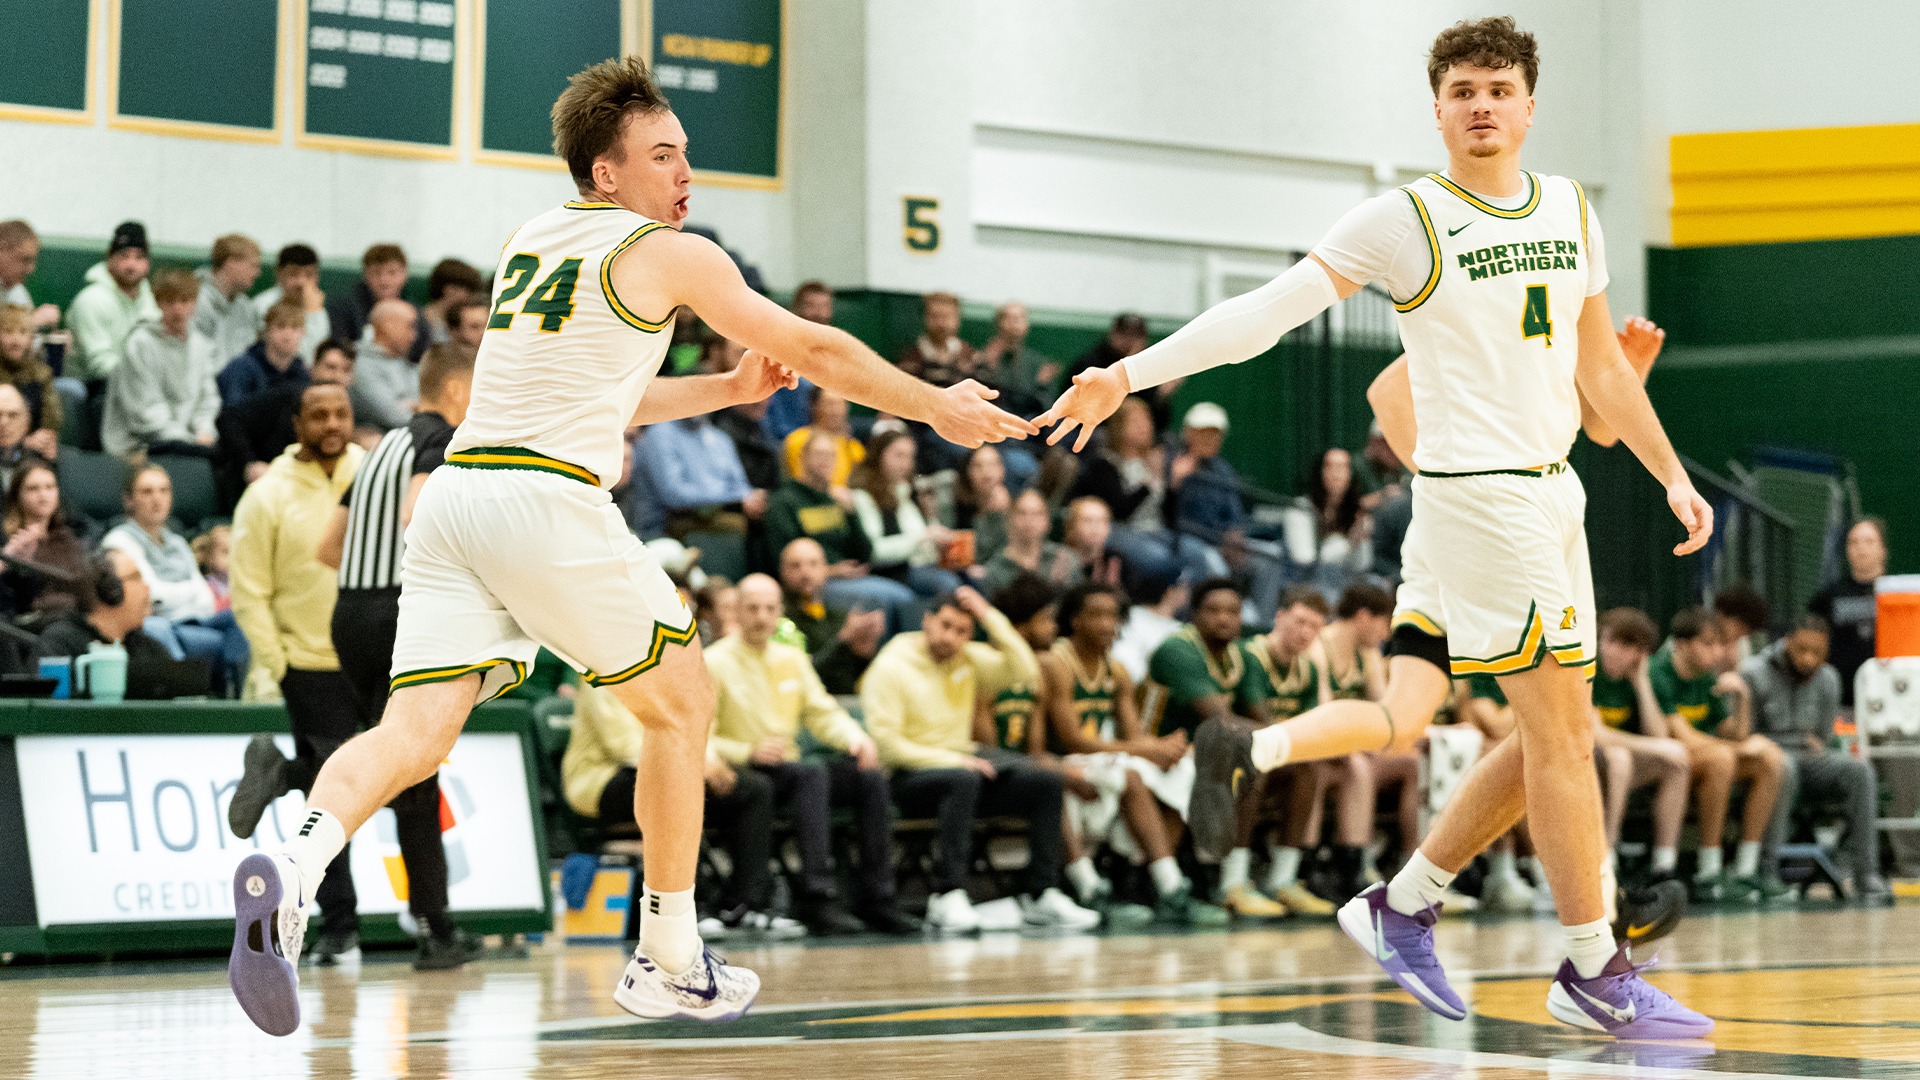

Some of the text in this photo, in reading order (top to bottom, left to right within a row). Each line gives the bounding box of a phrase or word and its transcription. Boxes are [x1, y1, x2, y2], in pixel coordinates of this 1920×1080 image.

[903, 195, 941, 254] 5
[1456, 239, 1578, 269] NORTHERN
[1467, 255, 1577, 282] MICHIGAN
[486, 251, 584, 334] 24
[1520, 283, 1553, 349] 4
[113, 879, 231, 913] CREDIT
